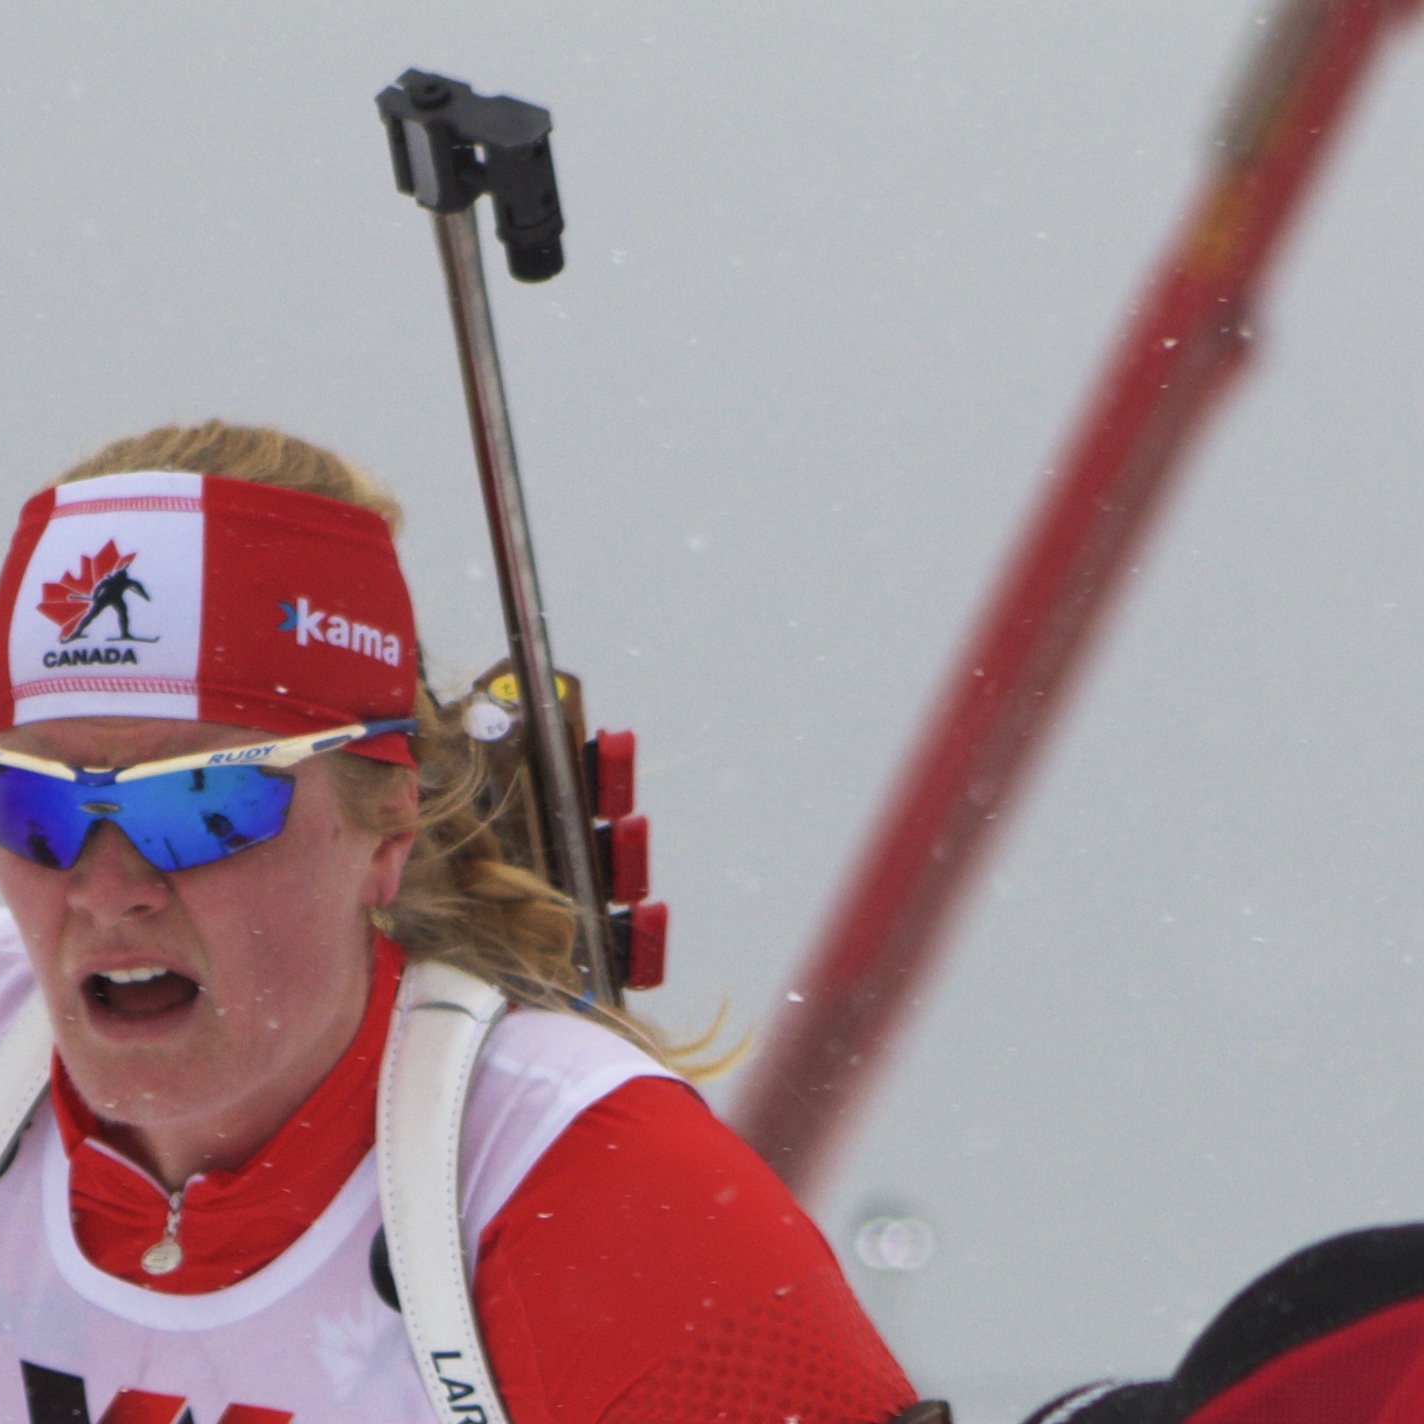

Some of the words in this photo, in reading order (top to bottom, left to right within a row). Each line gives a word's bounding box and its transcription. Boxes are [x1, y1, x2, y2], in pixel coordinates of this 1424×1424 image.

[295, 598, 400, 667] kama
[42, 646, 138, 669] CANADA
[206, 744, 278, 766] RUDY
